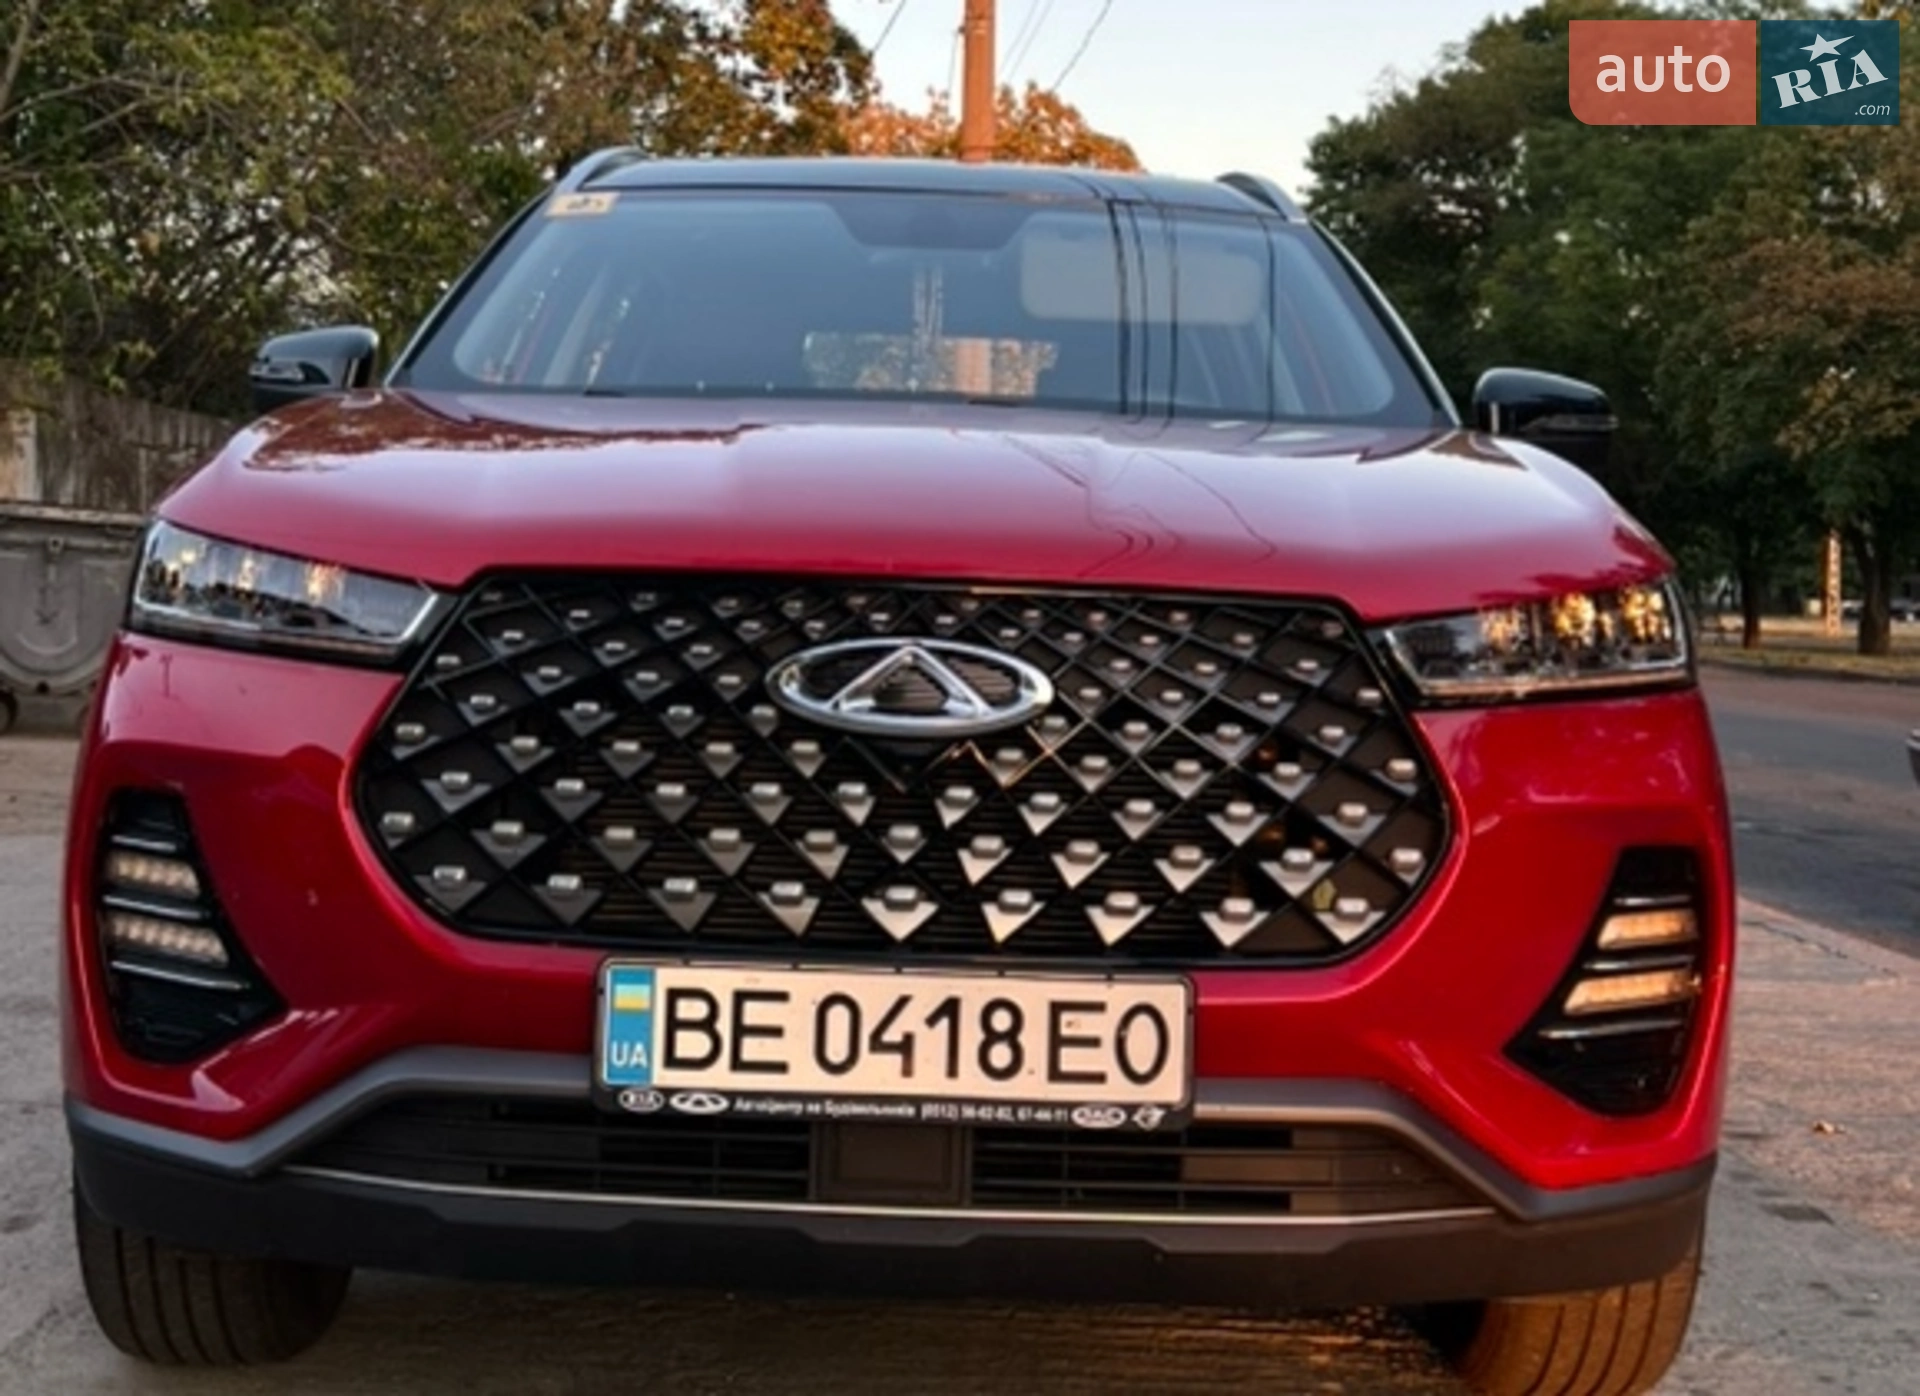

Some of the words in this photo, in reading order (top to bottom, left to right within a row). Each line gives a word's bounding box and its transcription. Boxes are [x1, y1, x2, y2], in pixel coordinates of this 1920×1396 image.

[611, 1041, 648, 1067] UA
[664, 987, 790, 1074] BE
[813, 992, 1024, 1080] 0418
[1048, 1001, 1169, 1086] EO
